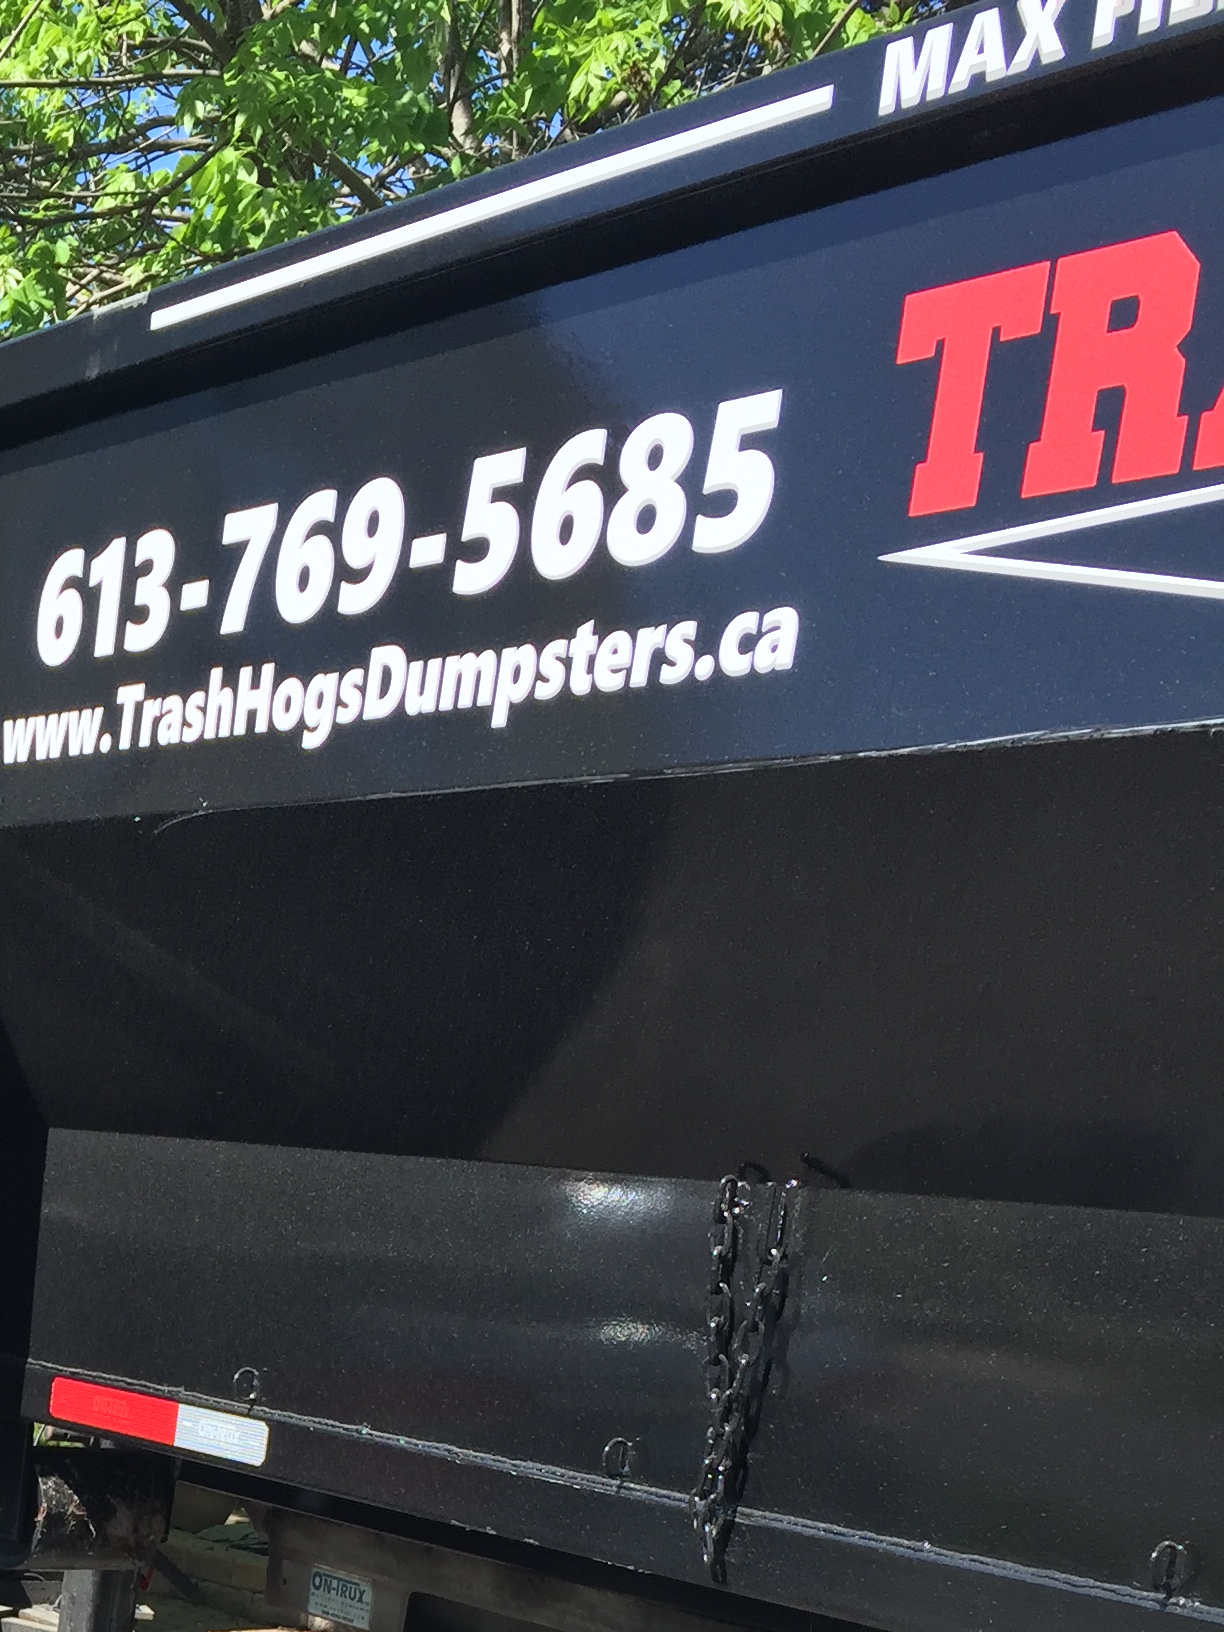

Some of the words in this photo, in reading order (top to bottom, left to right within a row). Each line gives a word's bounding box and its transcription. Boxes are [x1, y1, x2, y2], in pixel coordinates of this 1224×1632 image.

[878, 0, 1066, 117] MAX
[896, 229, 1224, 518] TR
[34, 388, 784, 667] 613-769-5685
[1, 604, 801, 764] www.TrashHogsDumpsters.ca
